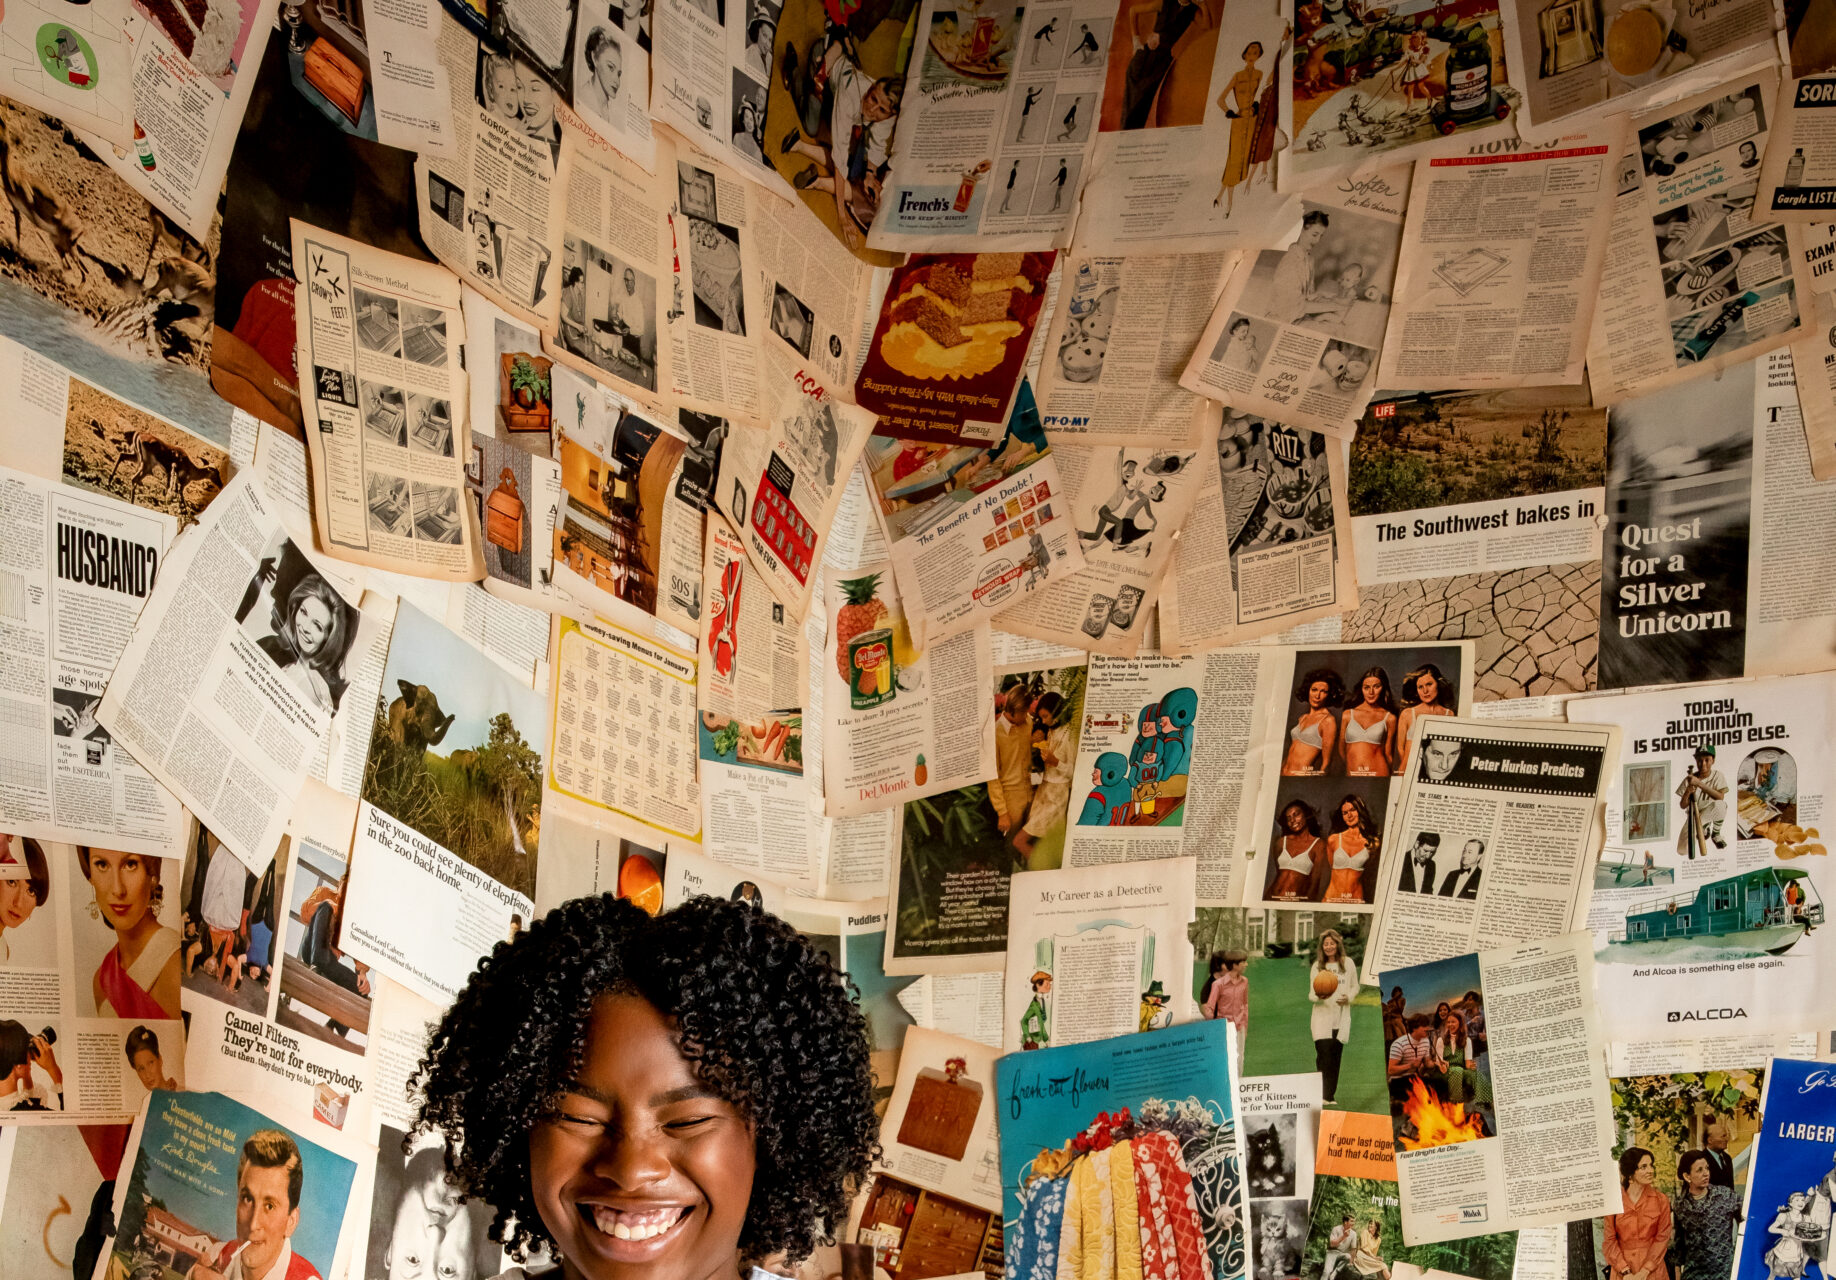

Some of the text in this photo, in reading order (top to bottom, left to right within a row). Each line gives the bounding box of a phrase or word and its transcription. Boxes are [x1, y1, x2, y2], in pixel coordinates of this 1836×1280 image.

[899, 191, 949, 213] French's
[1777, 194, 1807, 204] Gargle
[1812, 261, 1834, 278] LIFE
[1375, 405, 1395, 417] LIFE
[1272, 432, 1300, 461] RITZ
[916, 533, 934, 546] The
[936, 512, 971, 536] Benefit
[972, 504, 983, 515] of
[984, 496, 999, 509] No
[1376, 500, 1594, 542] The Southwest bakes in
[1622, 518, 1701, 550] Quest
[57, 522, 157, 598] HUSBAND?
[750, 533, 778, 573] WEAR-EVER
[1620, 554, 1684, 578] for a
[671, 575, 691, 597] SOS
[1619, 582, 1705, 608] Silver
[1619, 610, 1731, 638] Unicorn
[230, 642, 320, 738] RELIEVES ITS NERVOUS TENSION
[239, 641, 316, 724] TURNS OFF HEADACHE PAIN
[245, 671, 296, 724] AND DEPRESSION
[1634, 740, 1647, 754] IS
[1470, 757, 1585, 778] Peter Hurkos Predicts
[367, 824, 463, 892] in the zoo back home.
[370, 808, 532, 917] Sure you could see plenty of elephants
[1041, 883, 1163, 903] My Career as a Detective
[848, 914, 881, 926] Puddles
[1633, 968, 1650, 977] And
[1652, 967, 1677, 976] Alcoa
[1679, 966, 1686, 974] is
[1689, 963, 1735, 973] something
[1758, 960, 1785, 969] again.
[1682, 1008, 1747, 1021] ALCOA
[225, 1011, 301, 1052] Camel Filters.
[224, 1027, 364, 1093] They're not for everybody.
[1070, 1067, 1110, 1108] flowers
[1239, 1083, 1270, 1092] OFFER
[1329, 1133, 1335, 1143] If
[1337, 1136, 1355, 1147] your
[1357, 1137, 1372, 1147] last
[1778, 1121, 1835, 1143] LARGER
[1463, 1208, 1482, 1218] Midol
